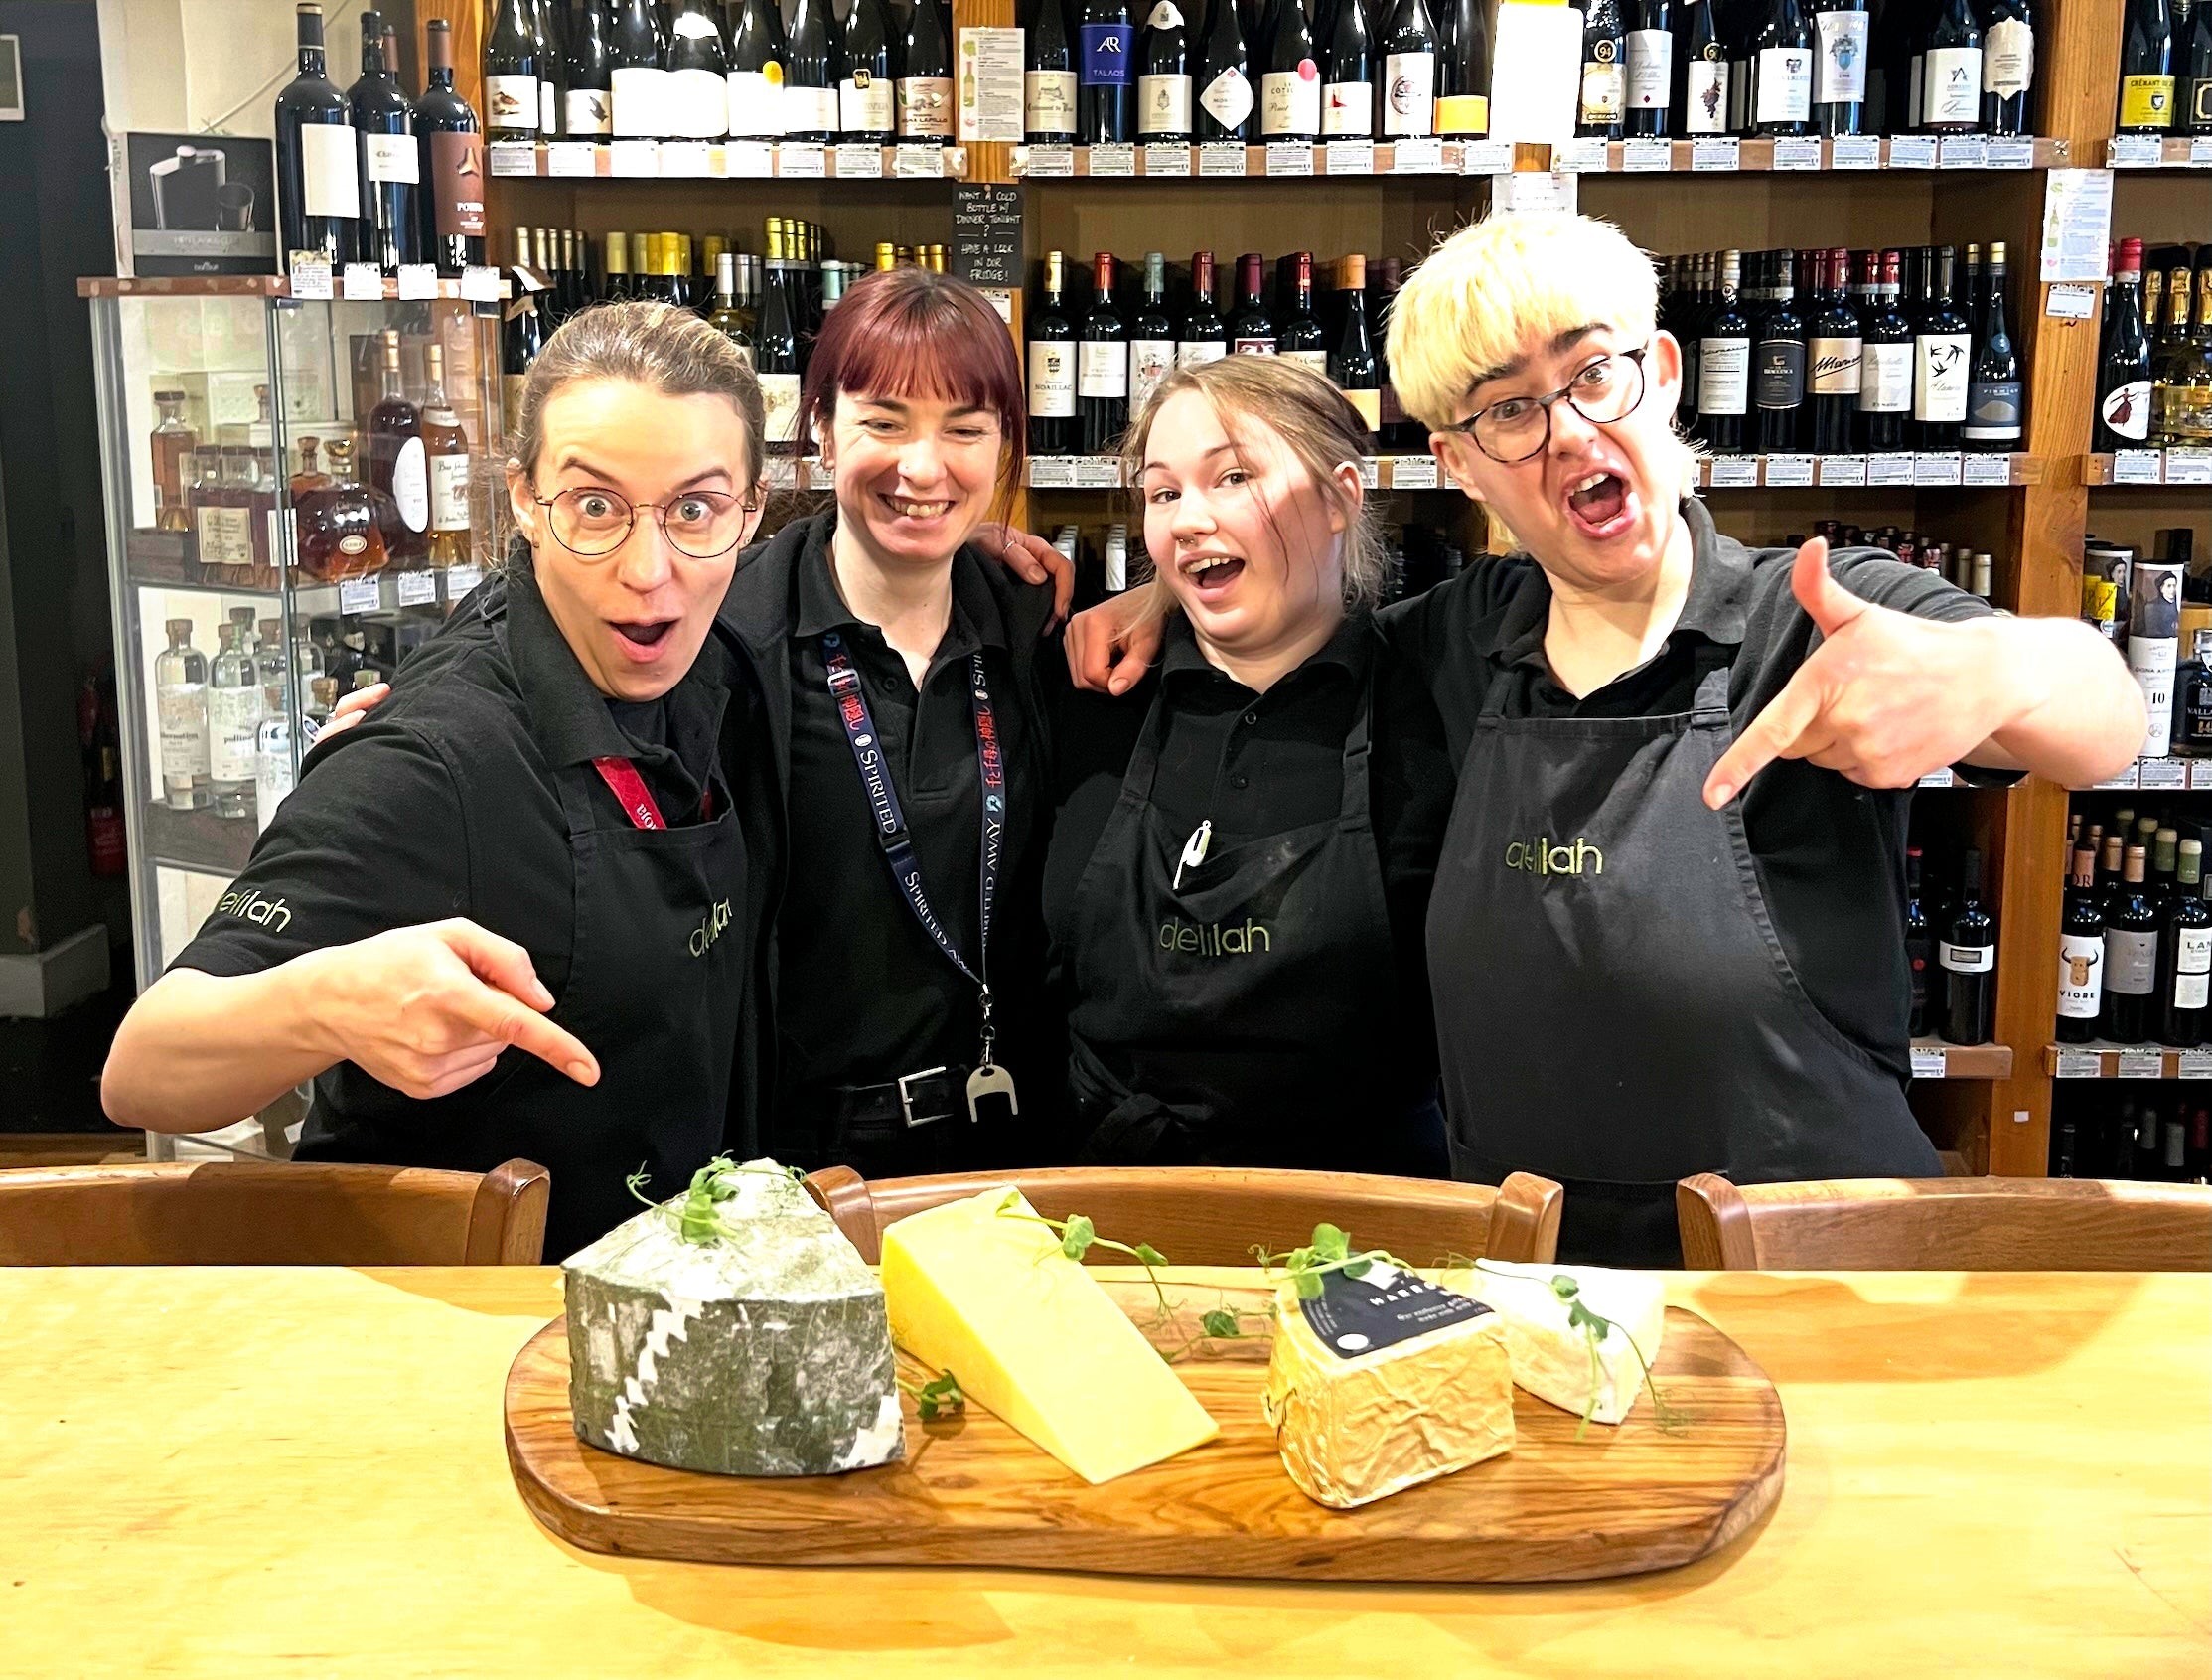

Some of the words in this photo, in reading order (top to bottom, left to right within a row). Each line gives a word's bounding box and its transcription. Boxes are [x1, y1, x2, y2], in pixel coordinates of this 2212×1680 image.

[1093, 69, 1125, 77] TALAOS
[959, 191, 981, 200] WANT
[984, 191, 991, 200] A
[996, 191, 1017, 202] COLD
[966, 202, 997, 213] BOTTLE
[955, 214, 985, 225] DINNER
[988, 214, 1022, 225] TONIGHT
[960, 243, 981, 255] HAVE
[982, 244, 990, 254] A
[993, 243, 1014, 254] LOOK
[973, 257, 984, 267] IN
[986, 257, 1003, 268] OUR
[2152, 692, 2165, 704] 10
[860, 749, 898, 834] SPIRITED
[986, 817, 1002, 871] AWAY
[1505, 837, 1603, 874] delilah
[219, 888, 292, 933] elilah
[904, 871, 948, 946] SPIRITED
[1160, 916, 1270, 956] delilah
[2060, 990, 2095, 998] VIORE
